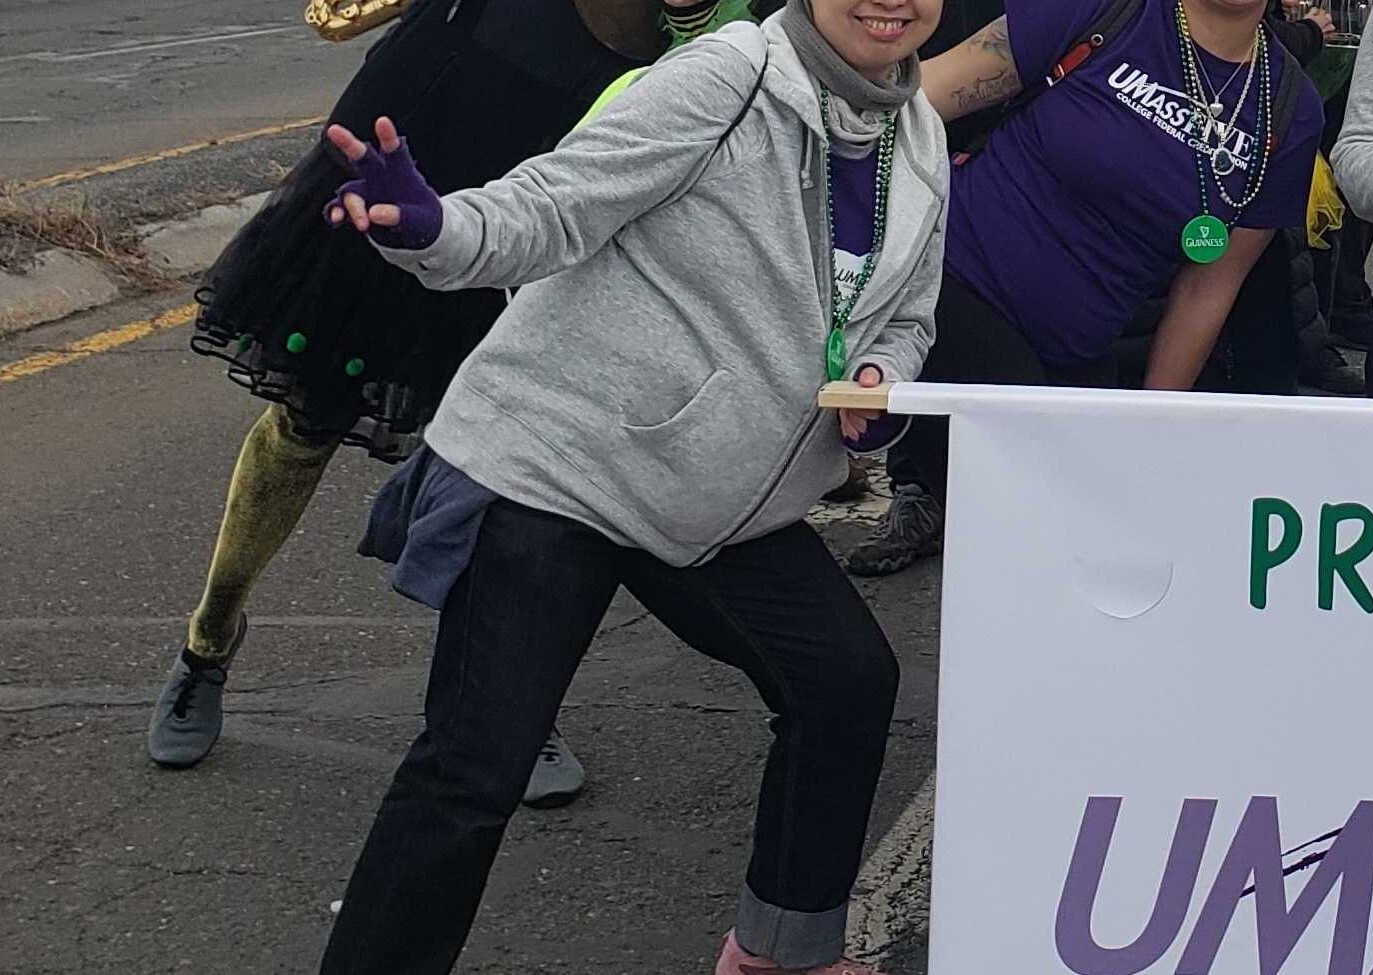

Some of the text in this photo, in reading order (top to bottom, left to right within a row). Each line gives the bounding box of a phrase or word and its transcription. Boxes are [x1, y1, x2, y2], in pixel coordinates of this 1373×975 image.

[1116, 92, 1152, 120] COLLEGE
[1152, 115, 1186, 143] FEDERAL
[1185, 237, 1225, 247] GUINNESS
